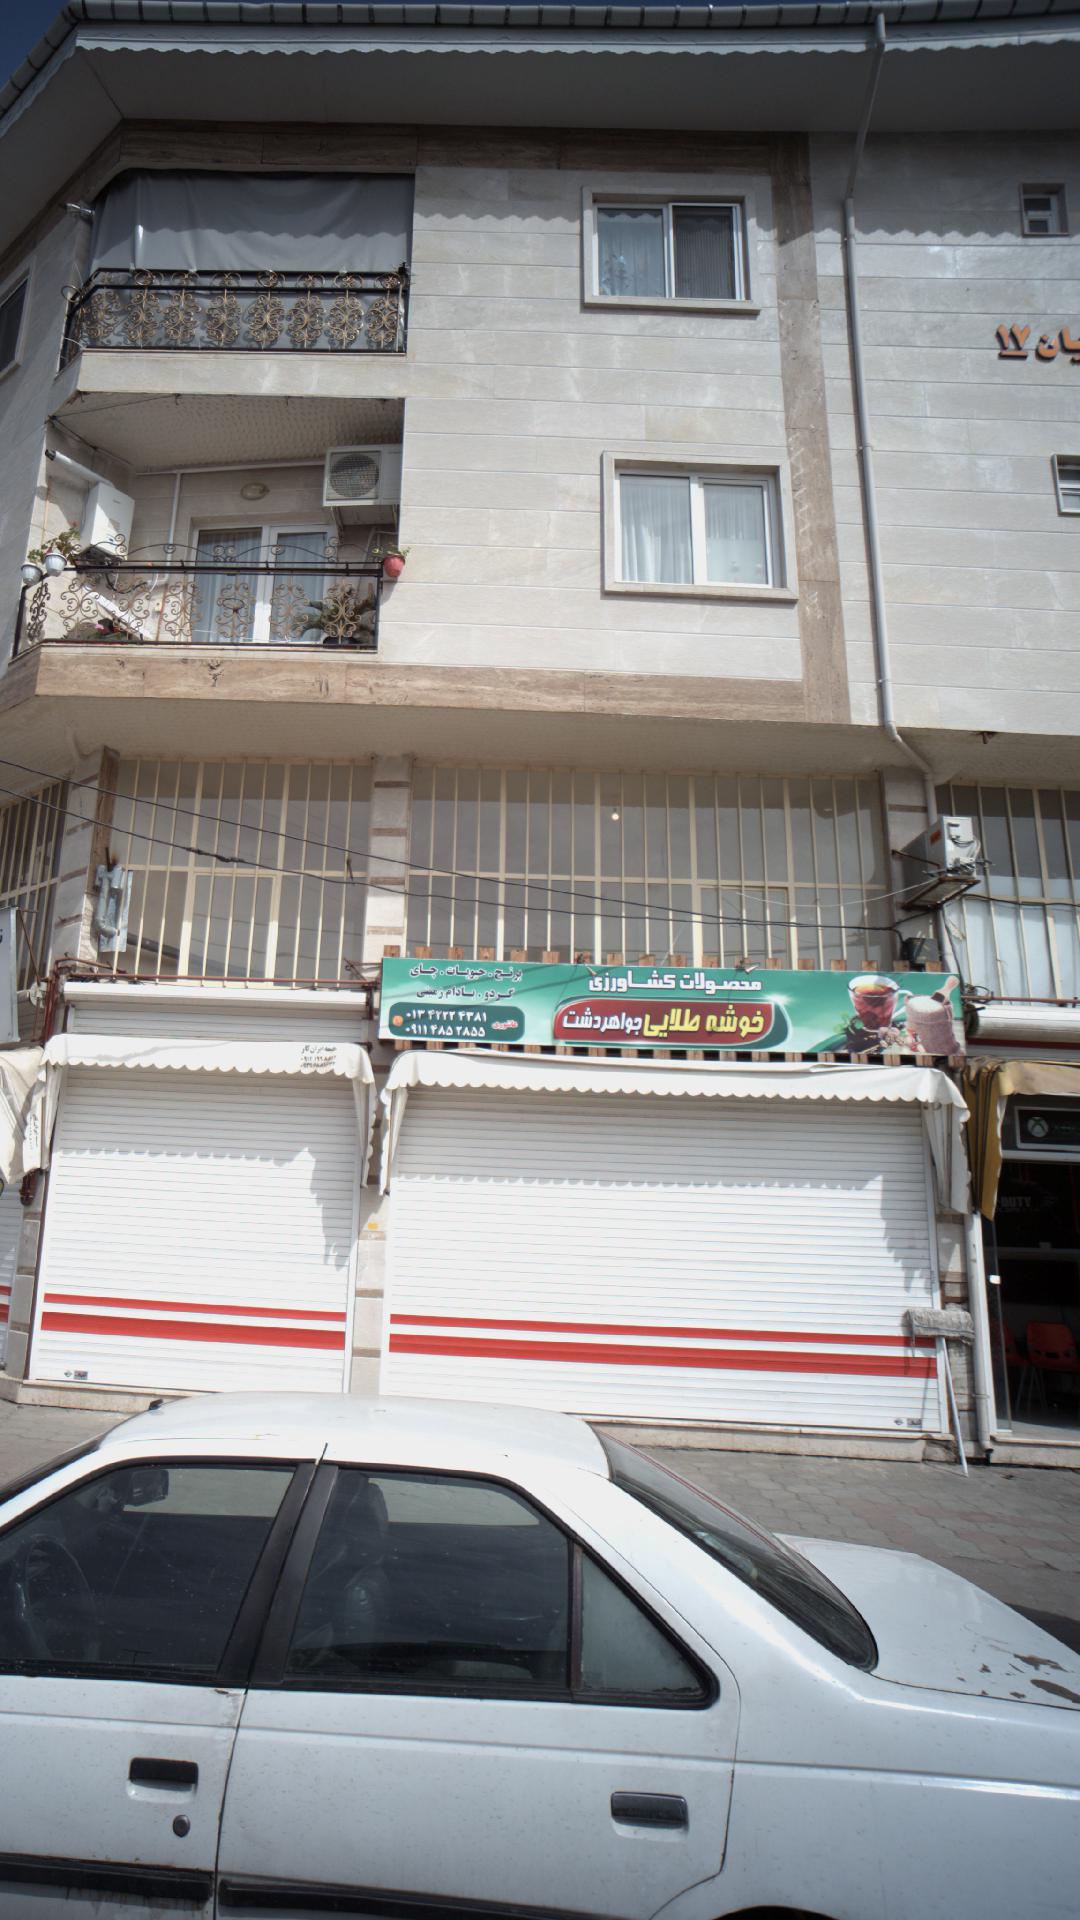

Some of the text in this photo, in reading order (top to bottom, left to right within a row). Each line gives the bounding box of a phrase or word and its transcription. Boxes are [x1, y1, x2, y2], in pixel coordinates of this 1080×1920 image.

[410, 963, 522, 982] برنج حبوبات چای
[588, 970, 762, 994] محصولات کشاورزی
[562, 1005, 765, 1037] خوشه طلایی جواهردشت
